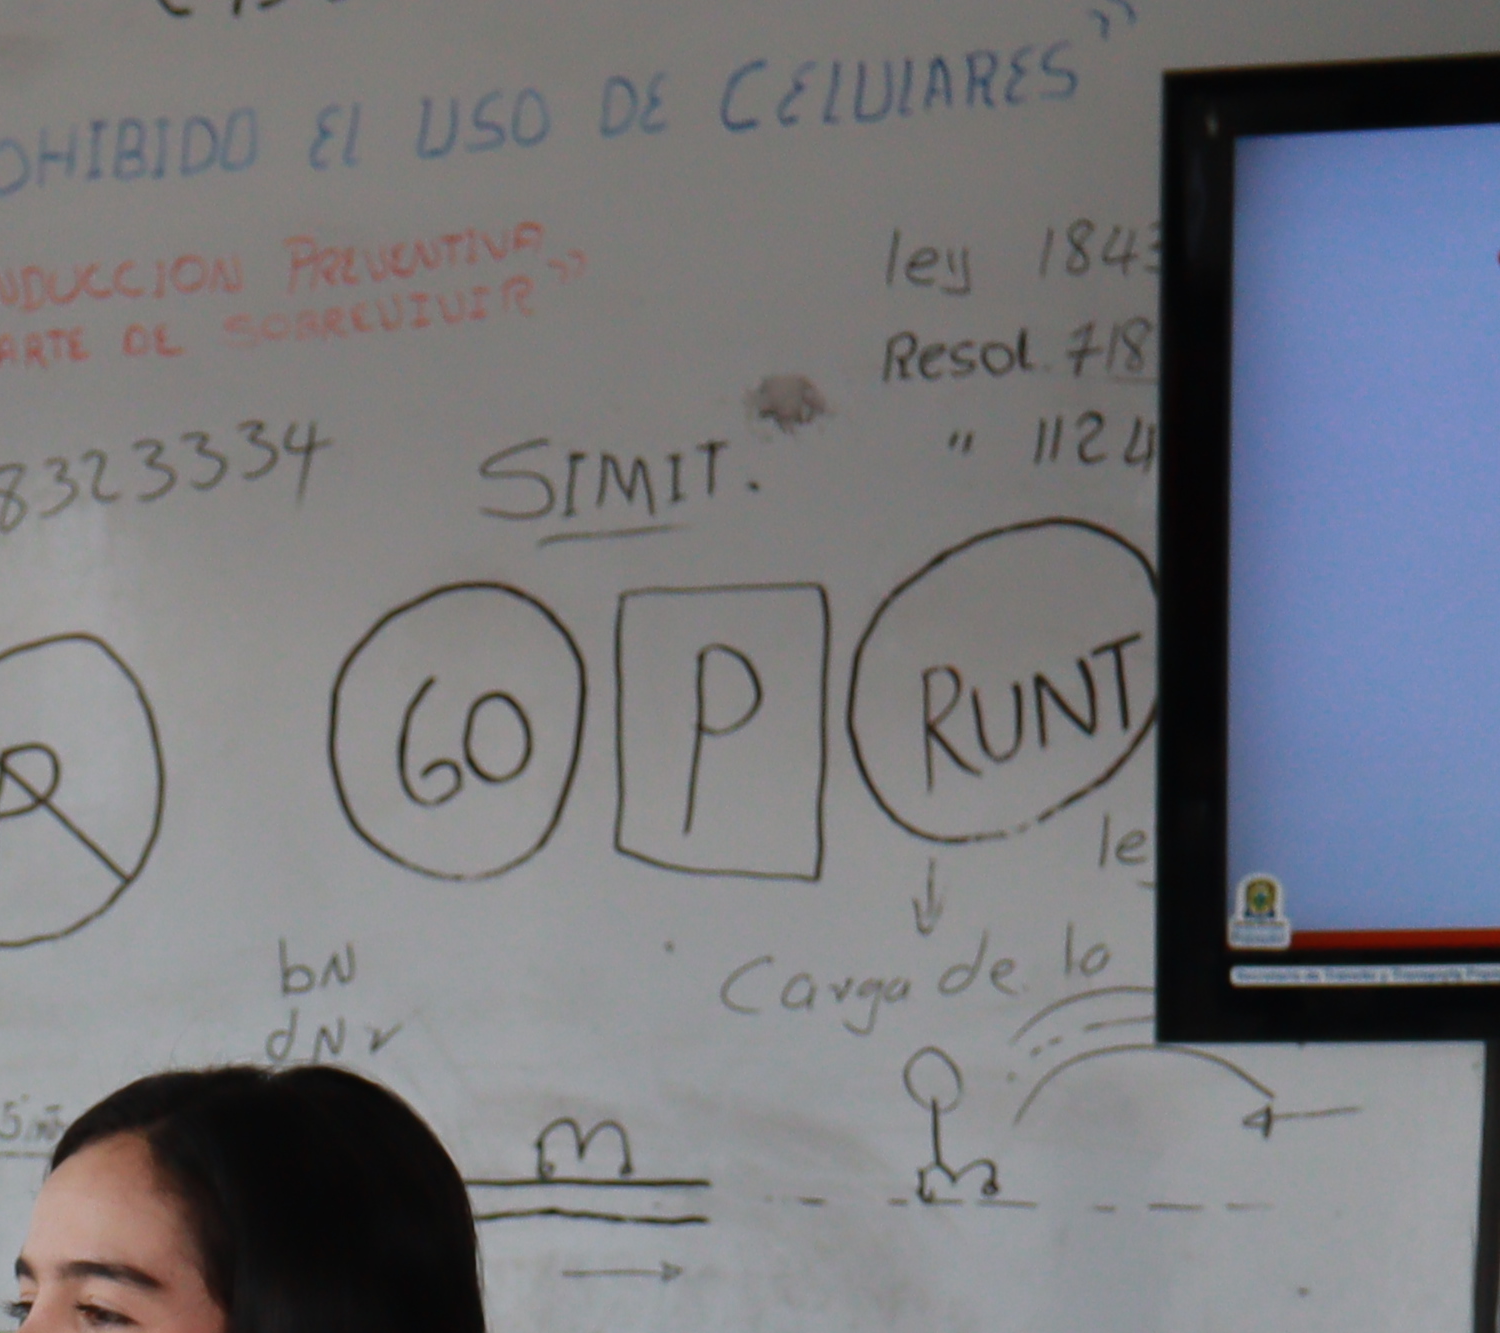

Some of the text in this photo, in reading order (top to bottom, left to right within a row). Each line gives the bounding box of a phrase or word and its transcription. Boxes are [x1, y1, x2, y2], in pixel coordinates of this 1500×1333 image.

[415, 86, 552, 160] USO
[599, 70, 670, 138] DE
[123, 324, 187, 358] DE
[682, 642, 764, 836] P
[920, 632, 1144, 794] RUNT
